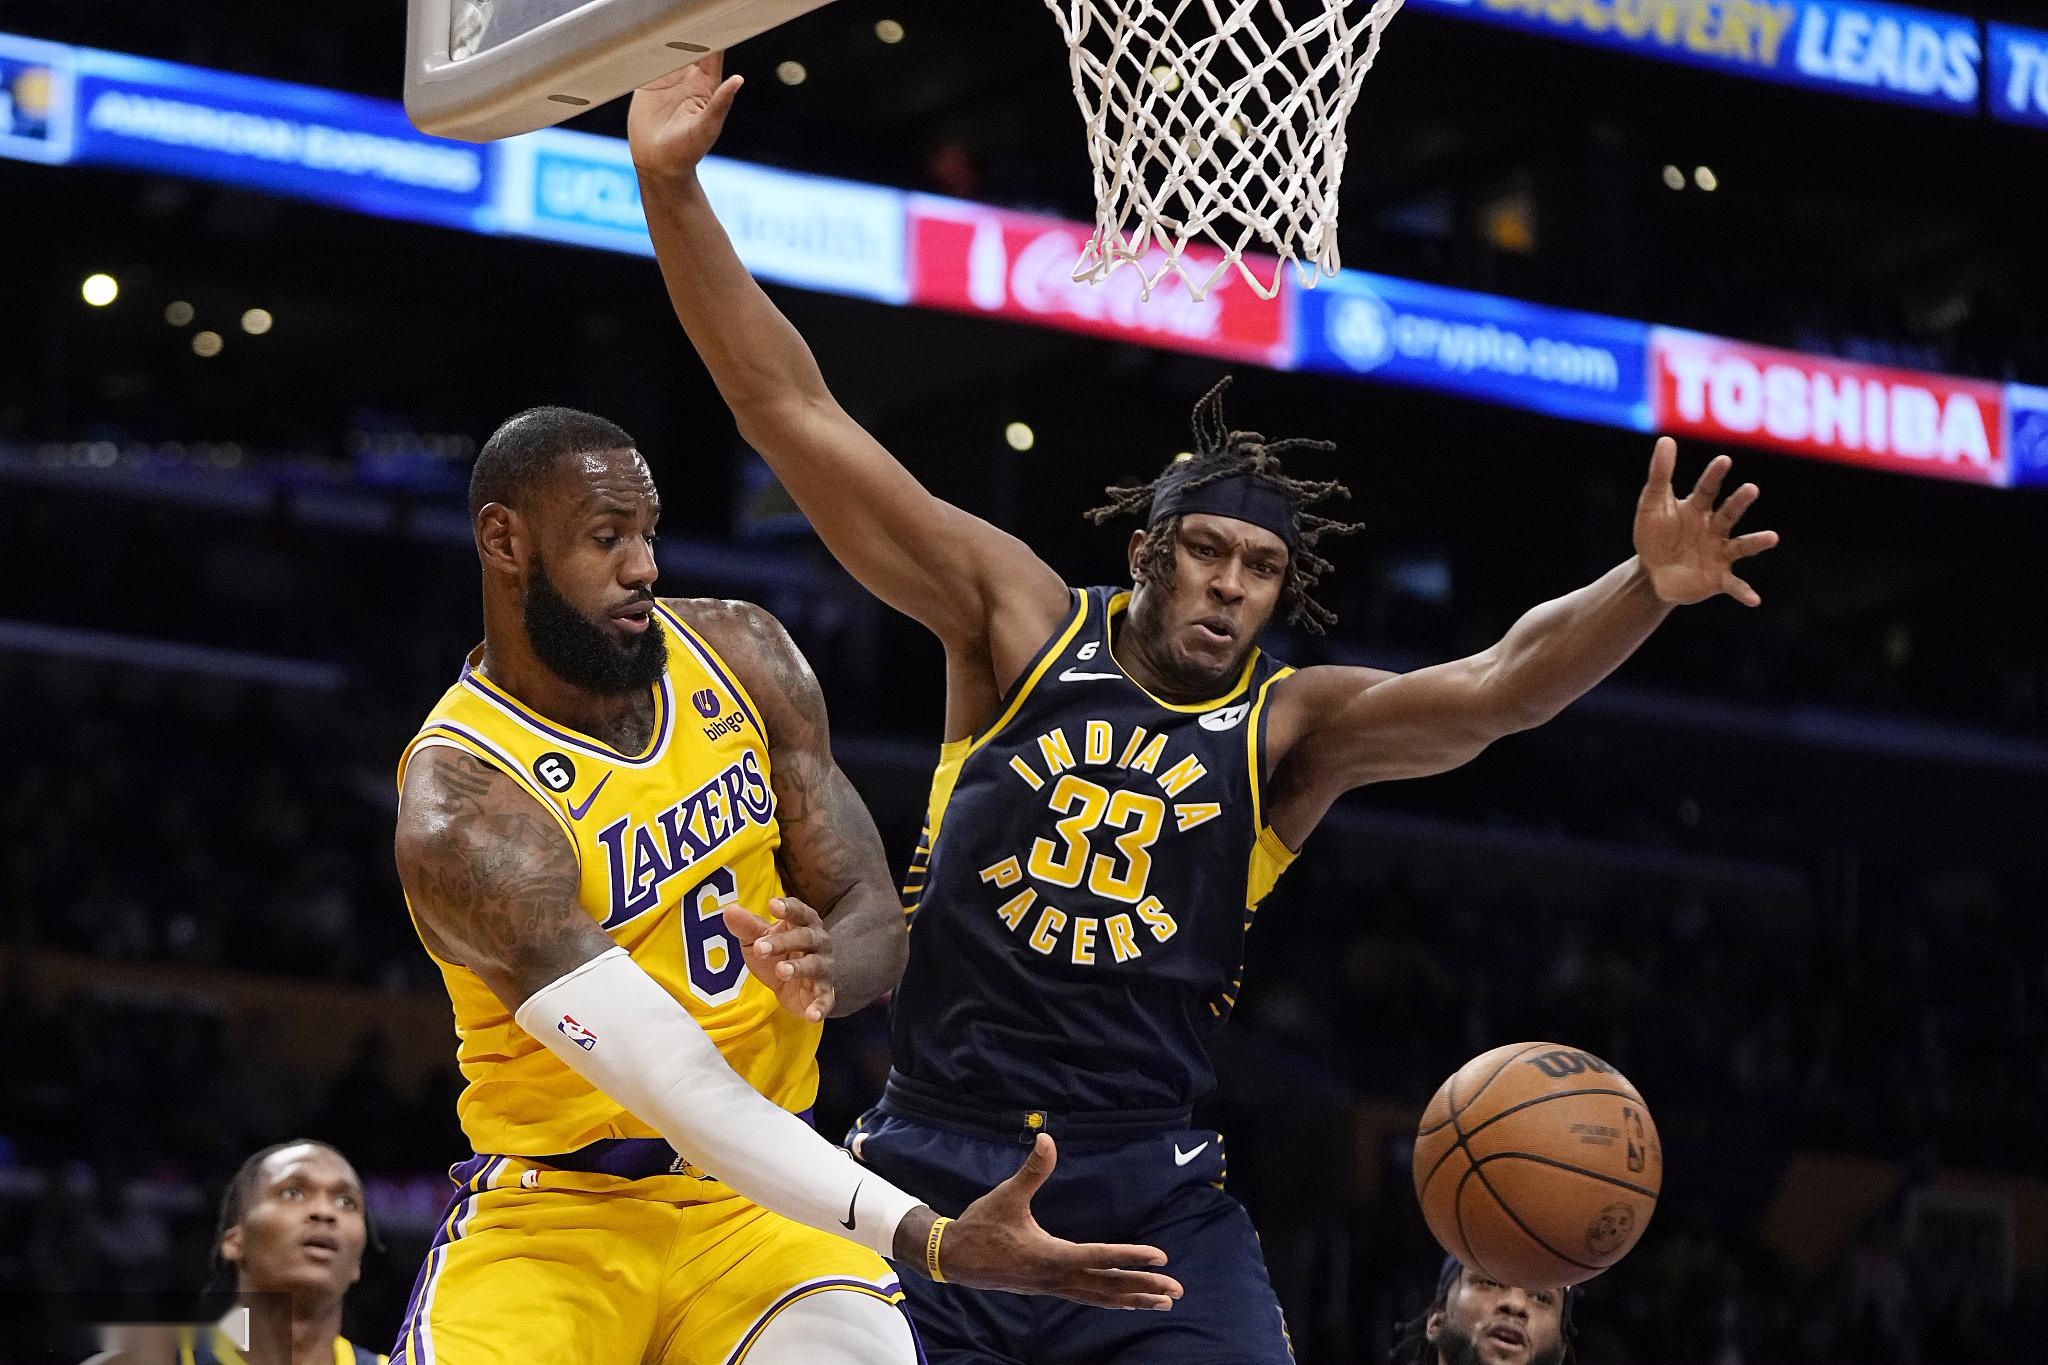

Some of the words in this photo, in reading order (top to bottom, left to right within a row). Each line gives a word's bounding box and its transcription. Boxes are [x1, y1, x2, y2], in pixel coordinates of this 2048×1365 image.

[1795, 3, 1982, 102] LEADS
[1664, 351, 1995, 467] TOSHIBA
[1077, 641, 1100, 661] 6
[539, 758, 569, 789] 6
[703, 711, 745, 741] bibigo
[1009, 720, 1221, 832] INDIANA
[596, 749, 778, 932] LAKERS
[1027, 774, 1166, 904] 33
[680, 864, 751, 1008] 6
[979, 855, 1178, 965] PACERS
